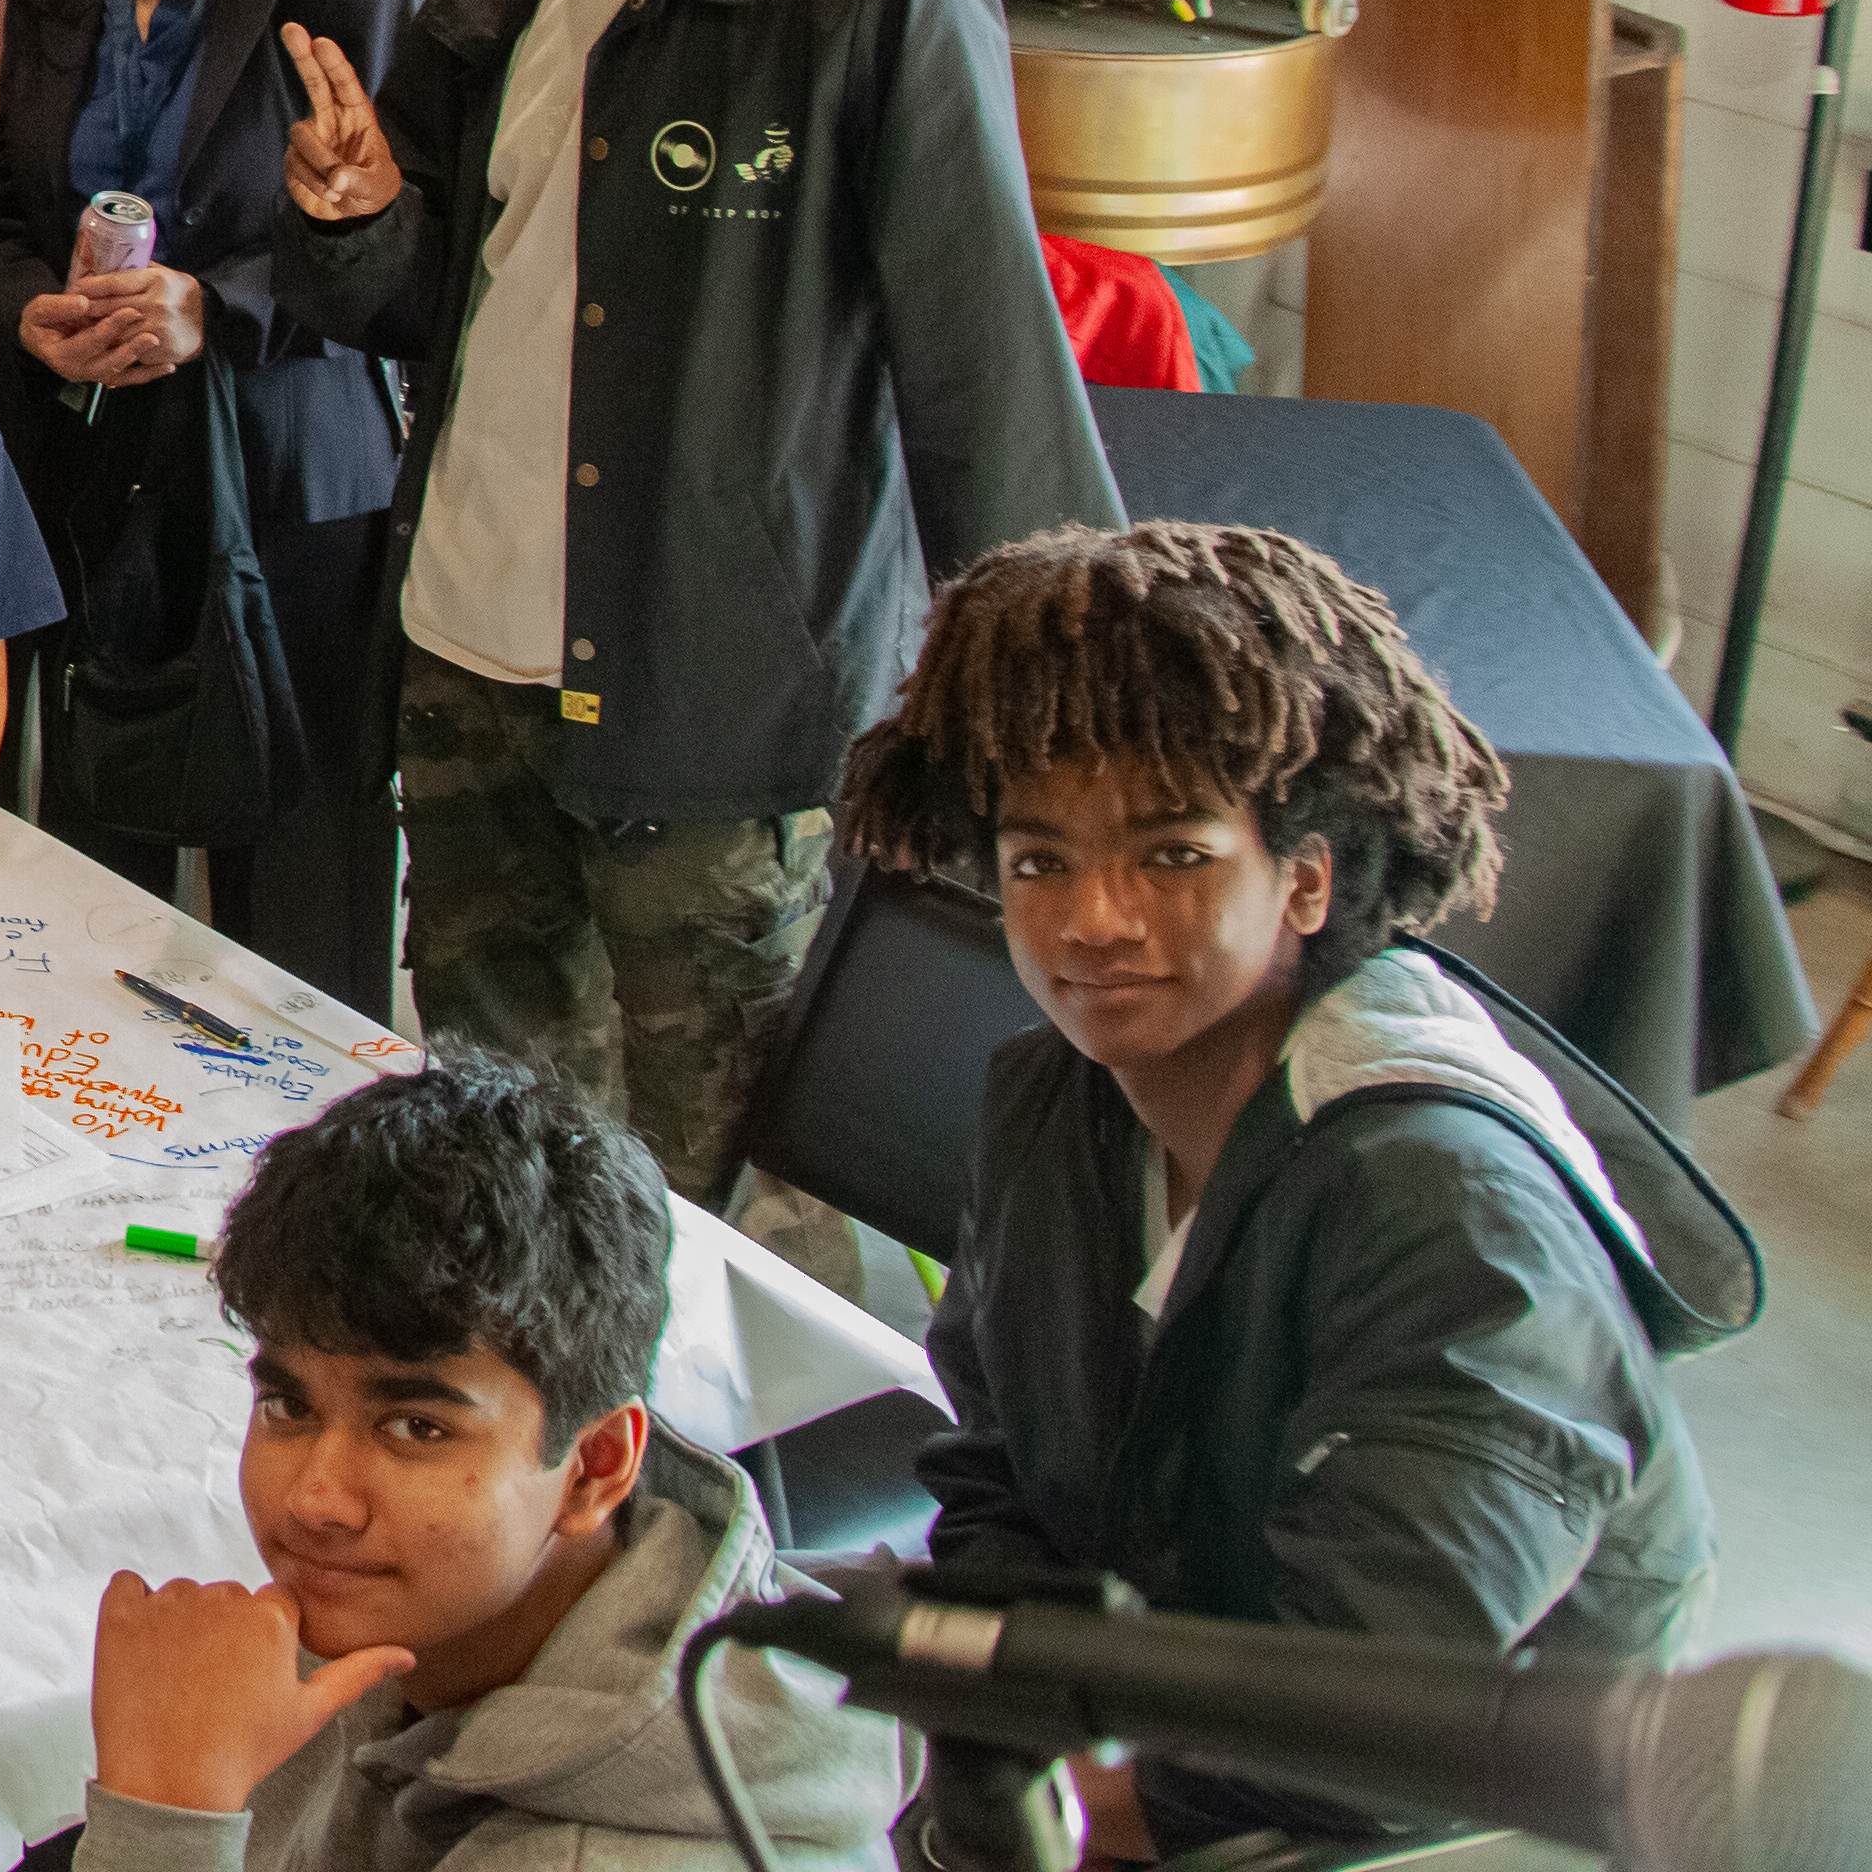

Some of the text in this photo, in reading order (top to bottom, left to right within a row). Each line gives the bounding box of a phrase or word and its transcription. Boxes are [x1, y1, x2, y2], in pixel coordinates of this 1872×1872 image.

[61, 1029, 110, 1047] of
[73, 1087, 167, 1132] Voting
[71, 1110, 131, 1140] No
